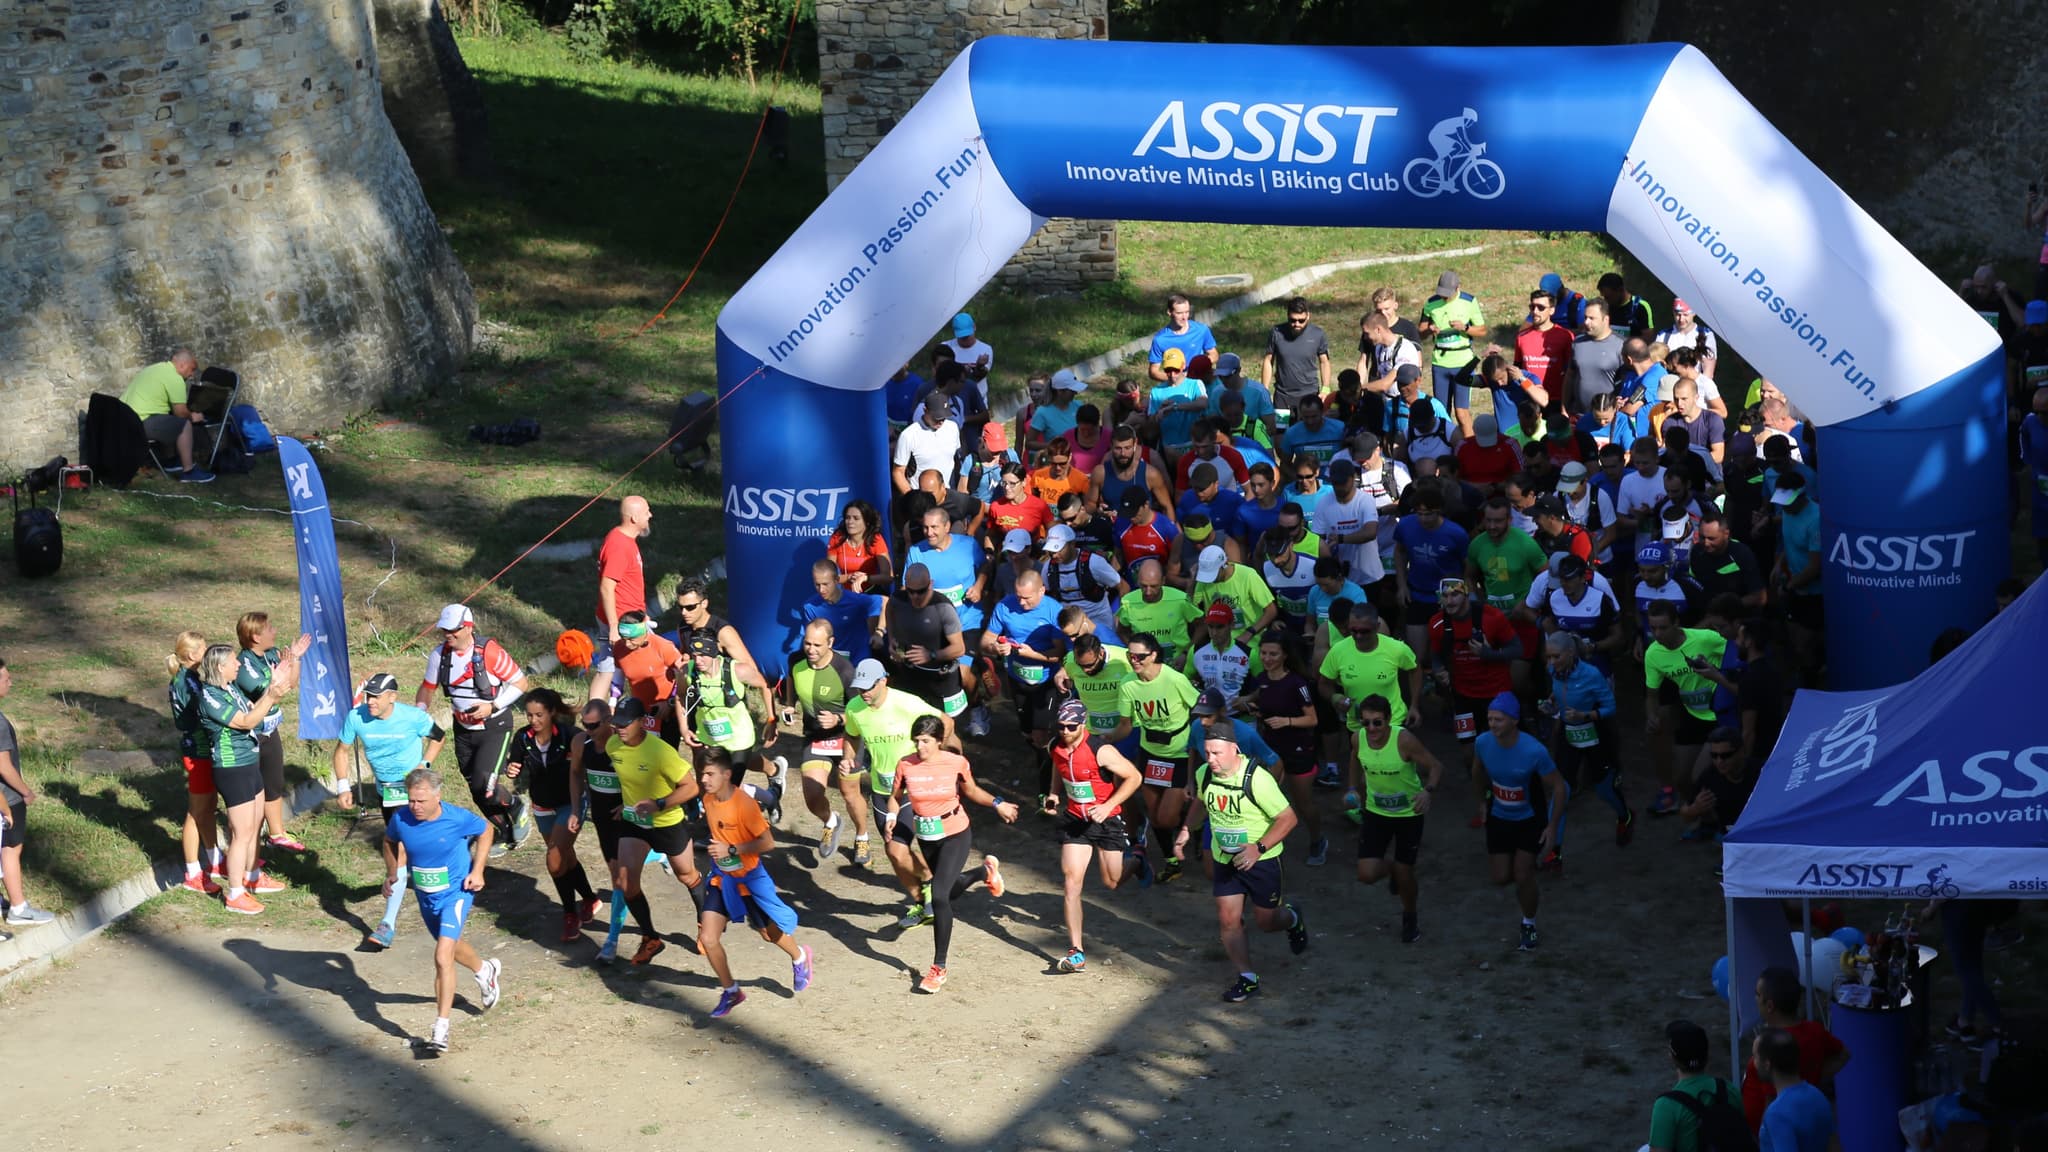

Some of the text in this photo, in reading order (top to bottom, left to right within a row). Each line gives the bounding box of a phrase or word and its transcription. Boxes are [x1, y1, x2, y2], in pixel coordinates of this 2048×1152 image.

[1132, 100, 1399, 165] ASSIST
[1066, 161, 1181, 185] Innovative
[1188, 167, 1254, 188] Minds
[1273, 170, 1342, 194] Biking
[1348, 171, 1399, 192] Club
[768, 147, 982, 363] Innovation. Passion. Fun.
[1629, 160, 1876, 401] Innovation. Passion. Fun.
[725, 484, 849, 522] ASSIST
[736, 521, 835, 537] Innovative Minds
[1829, 530, 1977, 572] ASSIST
[1846, 571, 1962, 588] Innovative Minds
[1082, 682, 1117, 692] IULIAN
[594, 775, 613, 786] 363
[1151, 765, 1167, 777] 139
[1222, 834, 1239, 844] 427
[420, 873, 441, 884] 355
[1797, 864, 1913, 887] ASSIST
